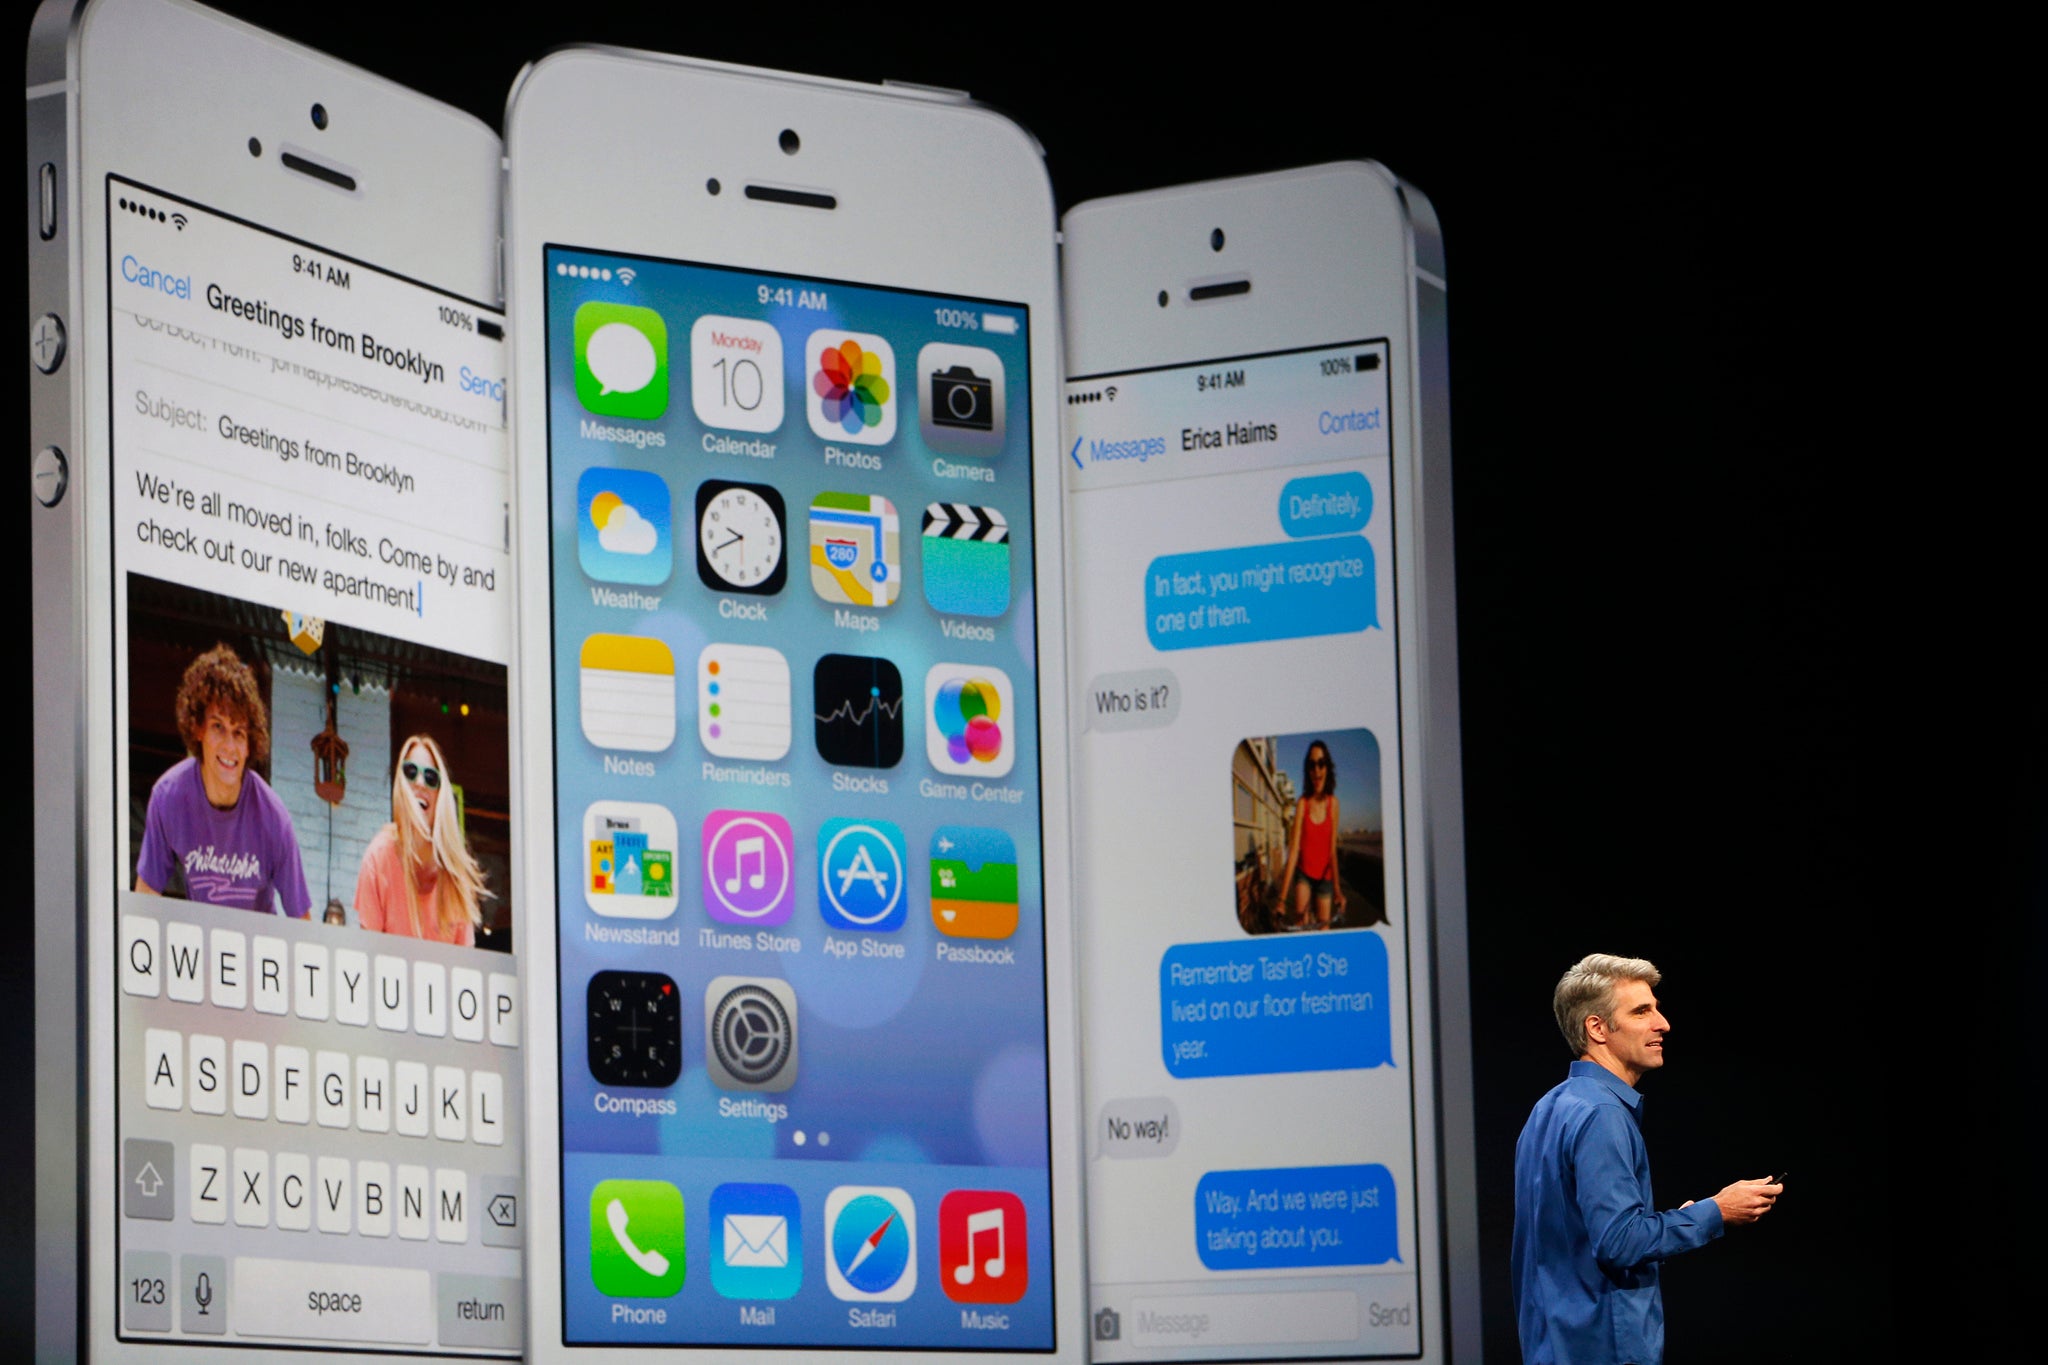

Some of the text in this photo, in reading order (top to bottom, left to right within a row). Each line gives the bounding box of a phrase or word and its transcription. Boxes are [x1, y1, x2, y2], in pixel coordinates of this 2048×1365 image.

[121, 255, 192, 299] Cancel
[292, 255, 351, 290] 9:41 AM
[757, 284, 828, 312] 9:41 AM
[439, 306, 473, 331] 100%
[933, 309, 978, 330] 100%
[207, 284, 444, 382] Greetings from Brooklyn
[711, 331, 764, 355] Monday
[1320, 358, 1350, 377] 100%
[712, 357, 764, 411] 10
[1197, 370, 1245, 392] 9:41 AM
[579, 420, 666, 449] Messages
[1319, 408, 1380, 436] Contact
[135, 390, 414, 493] Subject: Greetings from Brooklyn
[702, 433, 777, 460] Calendar
[1090, 435, 1166, 463] Messages
[1182, 422, 1278, 451] Erica Haims
[824, 447, 882, 471] Photos
[933, 457, 995, 483] Camera
[1290, 494, 1362, 521] Definitely.
[136, 471, 496, 592] We're all moved in, folks. Come by and
[137, 519, 420, 613] check out our new apartment.
[830, 547, 855, 562] 280
[1155, 556, 1363, 598] In fact, you might recognize
[591, 587, 661, 612] Weather
[719, 599, 768, 623] Clock
[834, 609, 880, 633] Maps
[940, 619, 995, 642] Videos
[1156, 605, 1250, 634] one of them.
[1096, 685, 1169, 714] Who is it?
[604, 755, 656, 778] Notes
[702, 763, 791, 789] Reminders
[832, 772, 889, 795] Stocks
[919, 778, 1024, 803] Game Center
[183, 845, 262, 882] Philadelphia
[584, 922, 680, 947] Newsstand
[699, 928, 801, 953] iTunes Store
[823, 936, 905, 961] App Store
[936, 942, 1015, 965] Passbook
[130, 939, 153, 977] Q
[171, 945, 200, 981] W
[220, 952, 237, 987] E
[261, 959, 281, 992] R
[303, 965, 320, 998] T
[343, 971, 361, 1004] Y
[383, 978, 400, 1010] U
[458, 989, 477, 1021] O
[497, 995, 513, 1025] P
[1171, 952, 1347, 987] Remember Tasha? She
[609, 999, 622, 1011] W
[647, 1001, 657, 1013] N
[1171, 991, 1373, 1022] lived on our floor freshman
[612, 1045, 621, 1058] S
[648, 1046, 656, 1059] E
[1173, 1039, 1208, 1065] year.
[155, 1053, 495, 1123] A S D F G H J K L
[594, 1092, 677, 1117] Compass
[719, 1097, 789, 1121] Settings
[1108, 1115, 1169, 1143] No way!
[200, 1167, 462, 1223] Z X C V B N M
[1205, 1186, 1380, 1219] Way. And we were just
[1207, 1227, 1343, 1255] talking about you.
[131, 1278, 166, 1305] 123
[308, 1288, 363, 1314] space
[457, 1298, 505, 1322] return
[612, 1305, 667, 1324] Phone
[740, 1307, 775, 1326] Mail
[848, 1308, 897, 1329] Safari
[961, 1310, 1010, 1330] Music
[1369, 1302, 1411, 1328] Send
